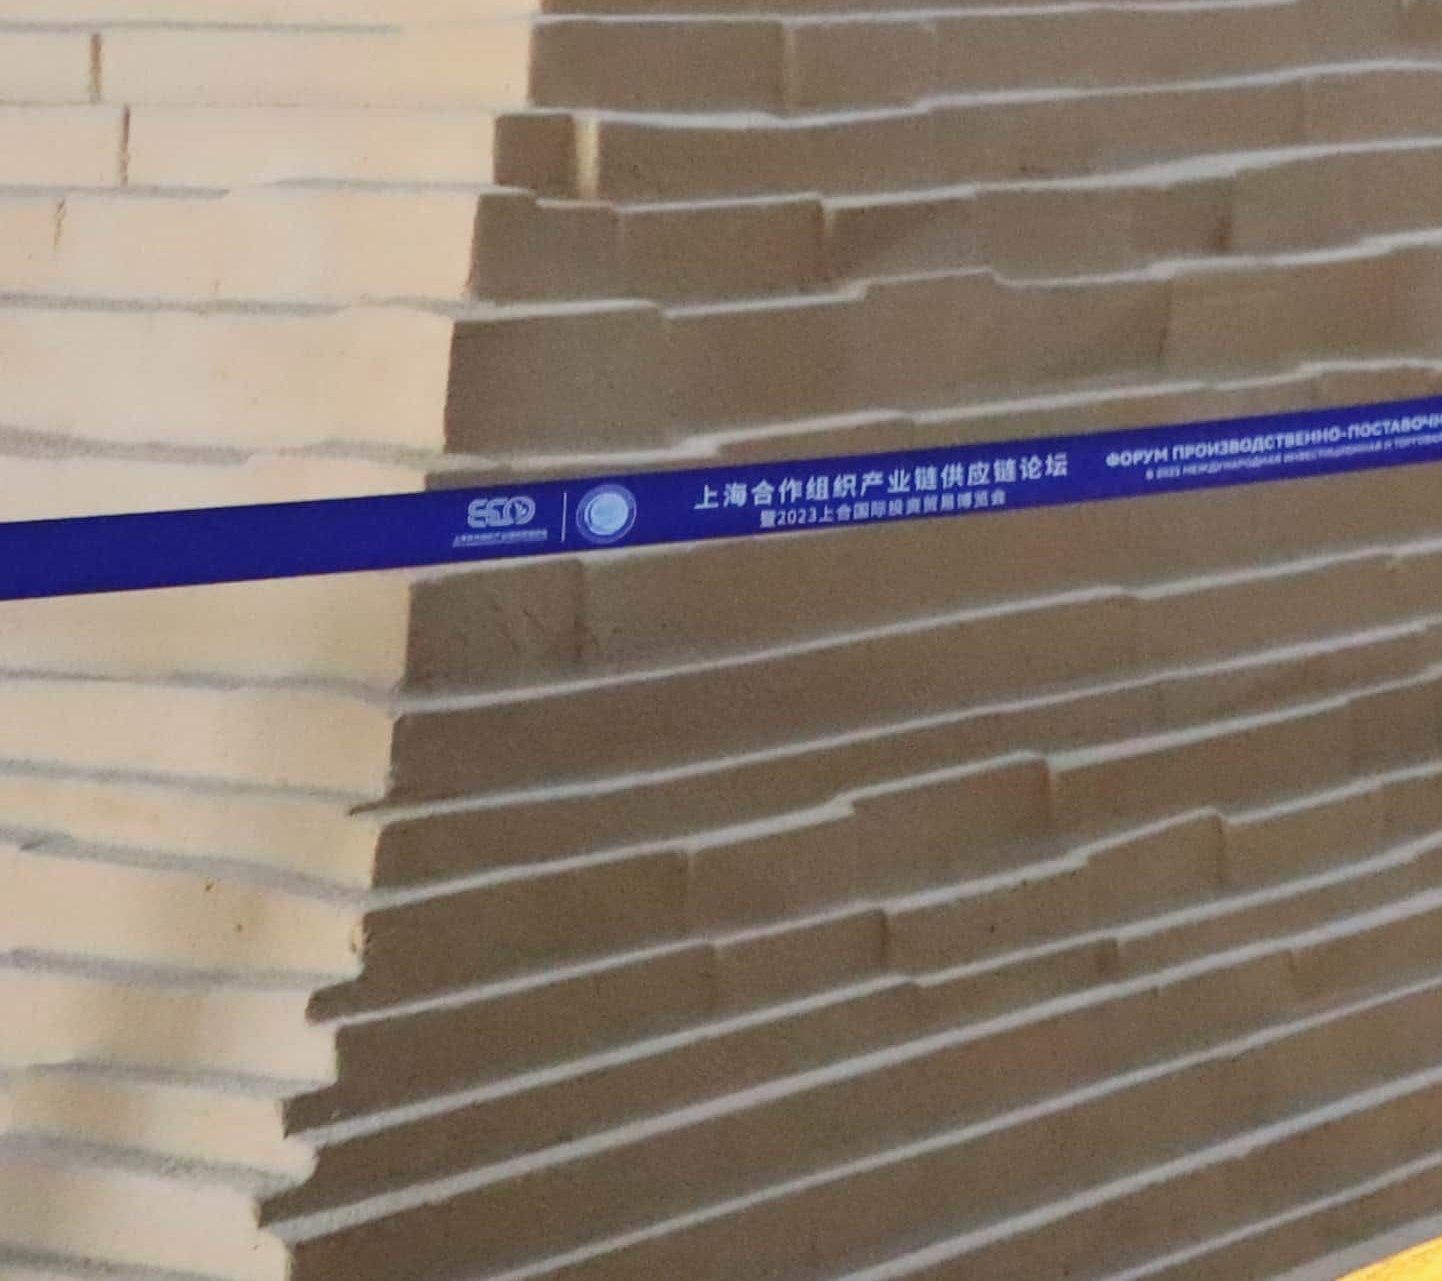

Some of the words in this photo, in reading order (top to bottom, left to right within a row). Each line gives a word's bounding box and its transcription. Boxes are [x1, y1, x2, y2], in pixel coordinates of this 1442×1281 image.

[1106, 447, 1168, 467] ФОРУМ
[693, 452, 1069, 510] 上海合作组织产业链供应链论坛
